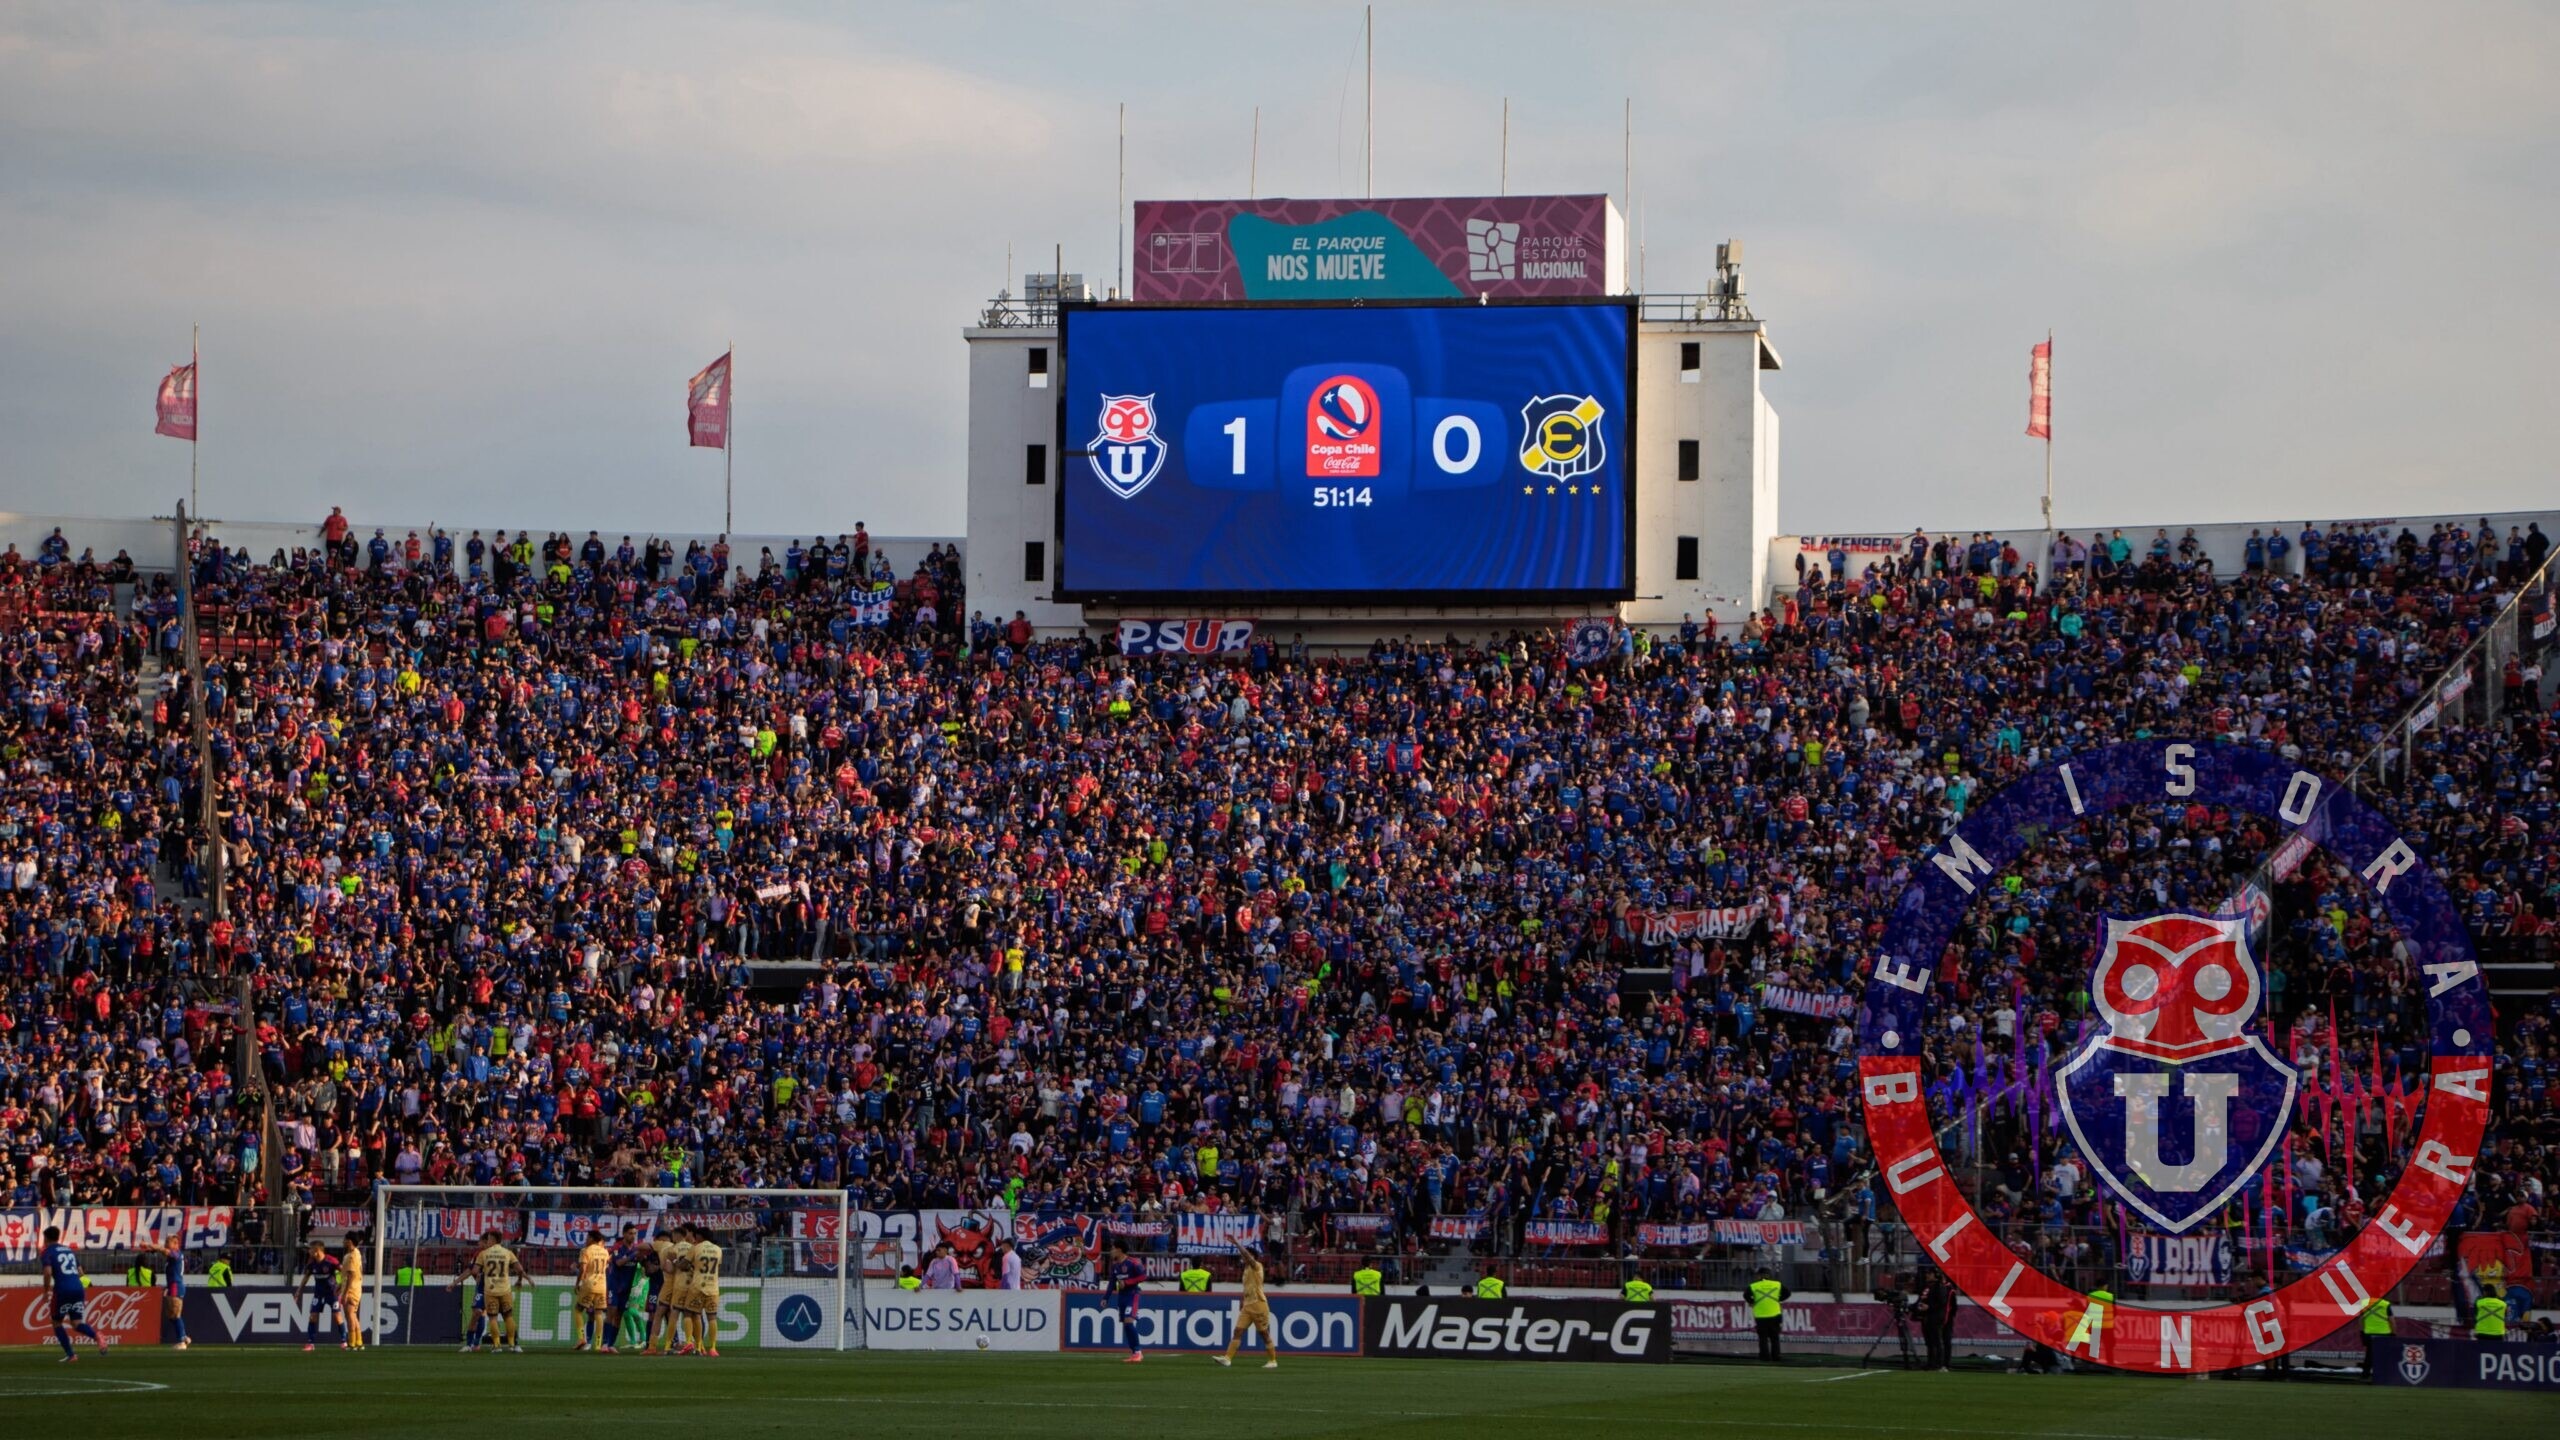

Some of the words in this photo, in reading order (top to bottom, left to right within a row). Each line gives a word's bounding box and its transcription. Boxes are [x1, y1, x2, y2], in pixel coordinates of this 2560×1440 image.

[1292, 238, 1311, 250] EL
[1317, 236, 1386, 252] PARQUE
[1522, 236, 1583, 248] PARQUE
[1522, 248, 1587, 259] ESTADIO
[1267, 255, 1308, 281] NOS
[1316, 254, 1386, 281] MUEVE
[1522, 262, 1588, 280] NACIONAL
[1223, 417, 1246, 475] 1
[1311, 444, 1343, 455] Copa
[1345, 444, 1376, 454] Chile
[1432, 415, 1482, 474] 0
[1313, 487, 1373, 507] 51:14
[39, 1206, 233, 1250] MASAKRES
[526, 1210, 568, 1248] LA
[57, 1252, 79, 1275] 23
[486, 1260, 506, 1278] 21
[699, 1256, 718, 1275] 37
[843, 1307, 941, 1332] ANDES
[948, 1307, 1048, 1333] SALUD
[1378, 1303, 1656, 1356] Master-G
